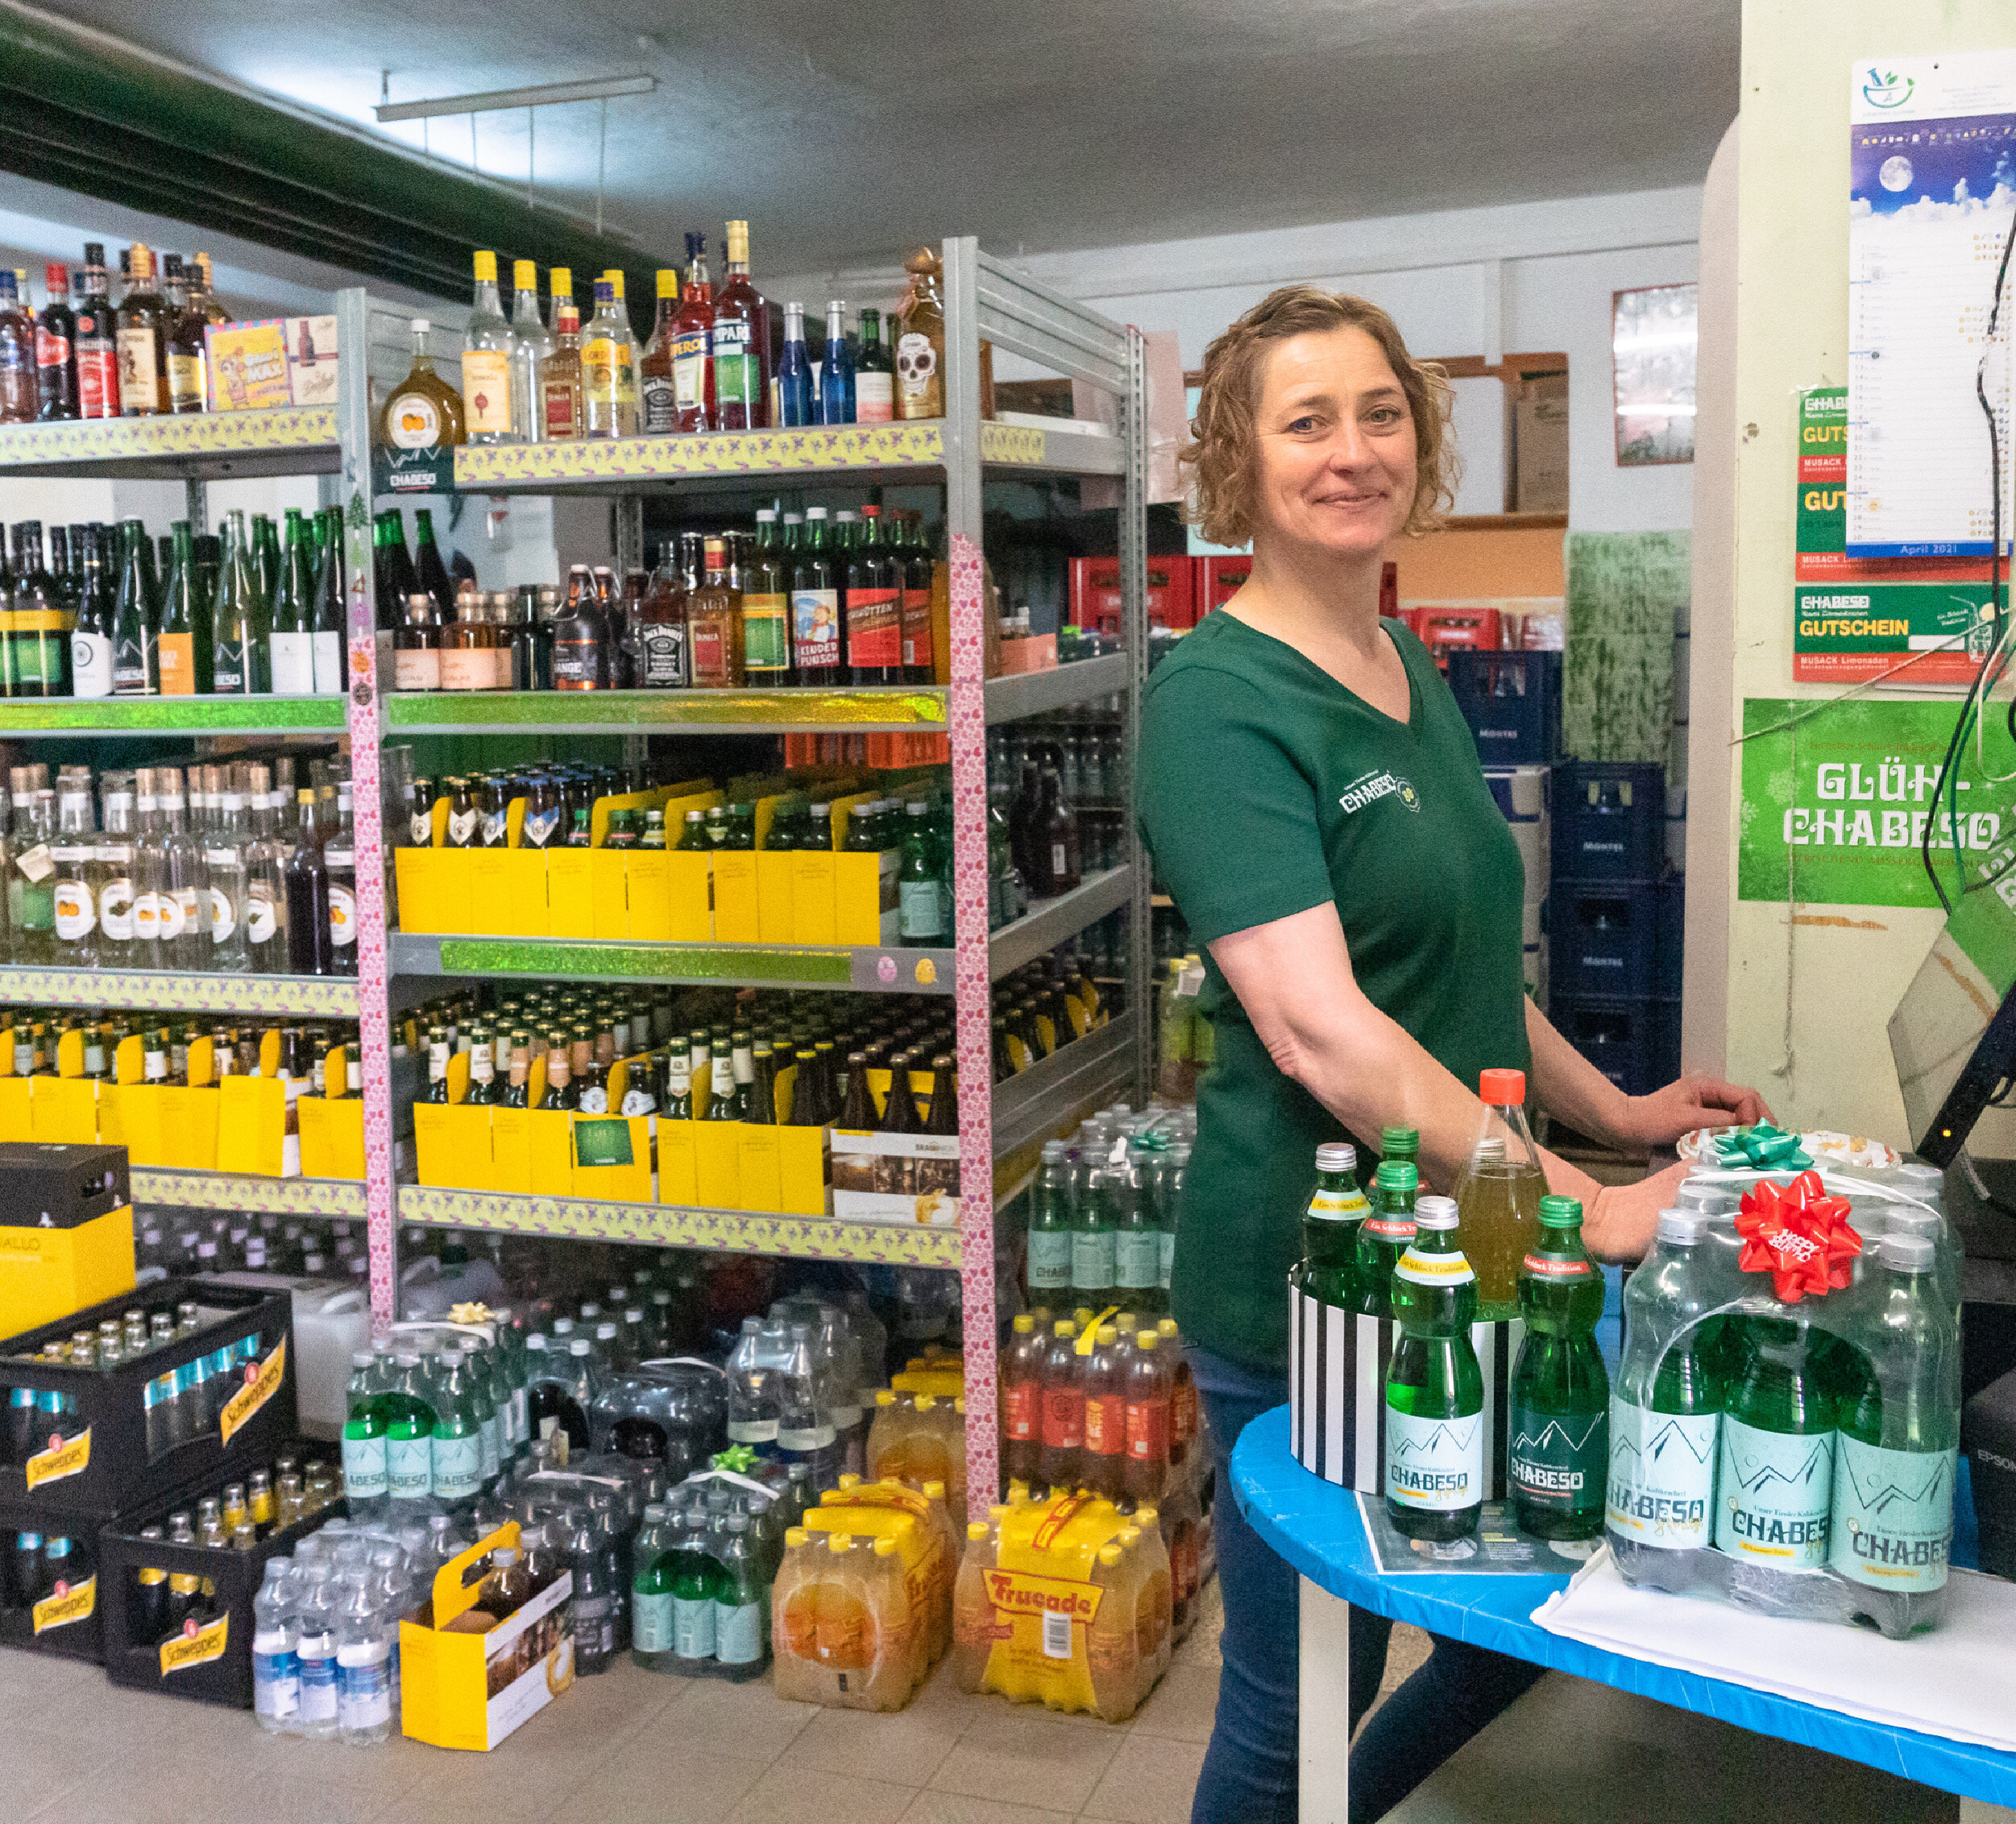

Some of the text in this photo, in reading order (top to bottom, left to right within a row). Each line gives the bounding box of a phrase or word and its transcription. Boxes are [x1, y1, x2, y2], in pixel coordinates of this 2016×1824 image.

[1803, 426, 1848, 443] GUTS
[1900, 545, 1957, 555] April 2021
[1801, 595, 1870, 609] CHABESO
[1799, 620, 1909, 636] GUTSCHEIN
[1817, 756, 1971, 802] GLÜH-
[1783, 808, 2001, 850] CHABESO
[1392, 1464, 1468, 1491] CHABESO
[1511, 1457, 1584, 1490] CHABESO
[1609, 1480, 1705, 1523] HABESO
